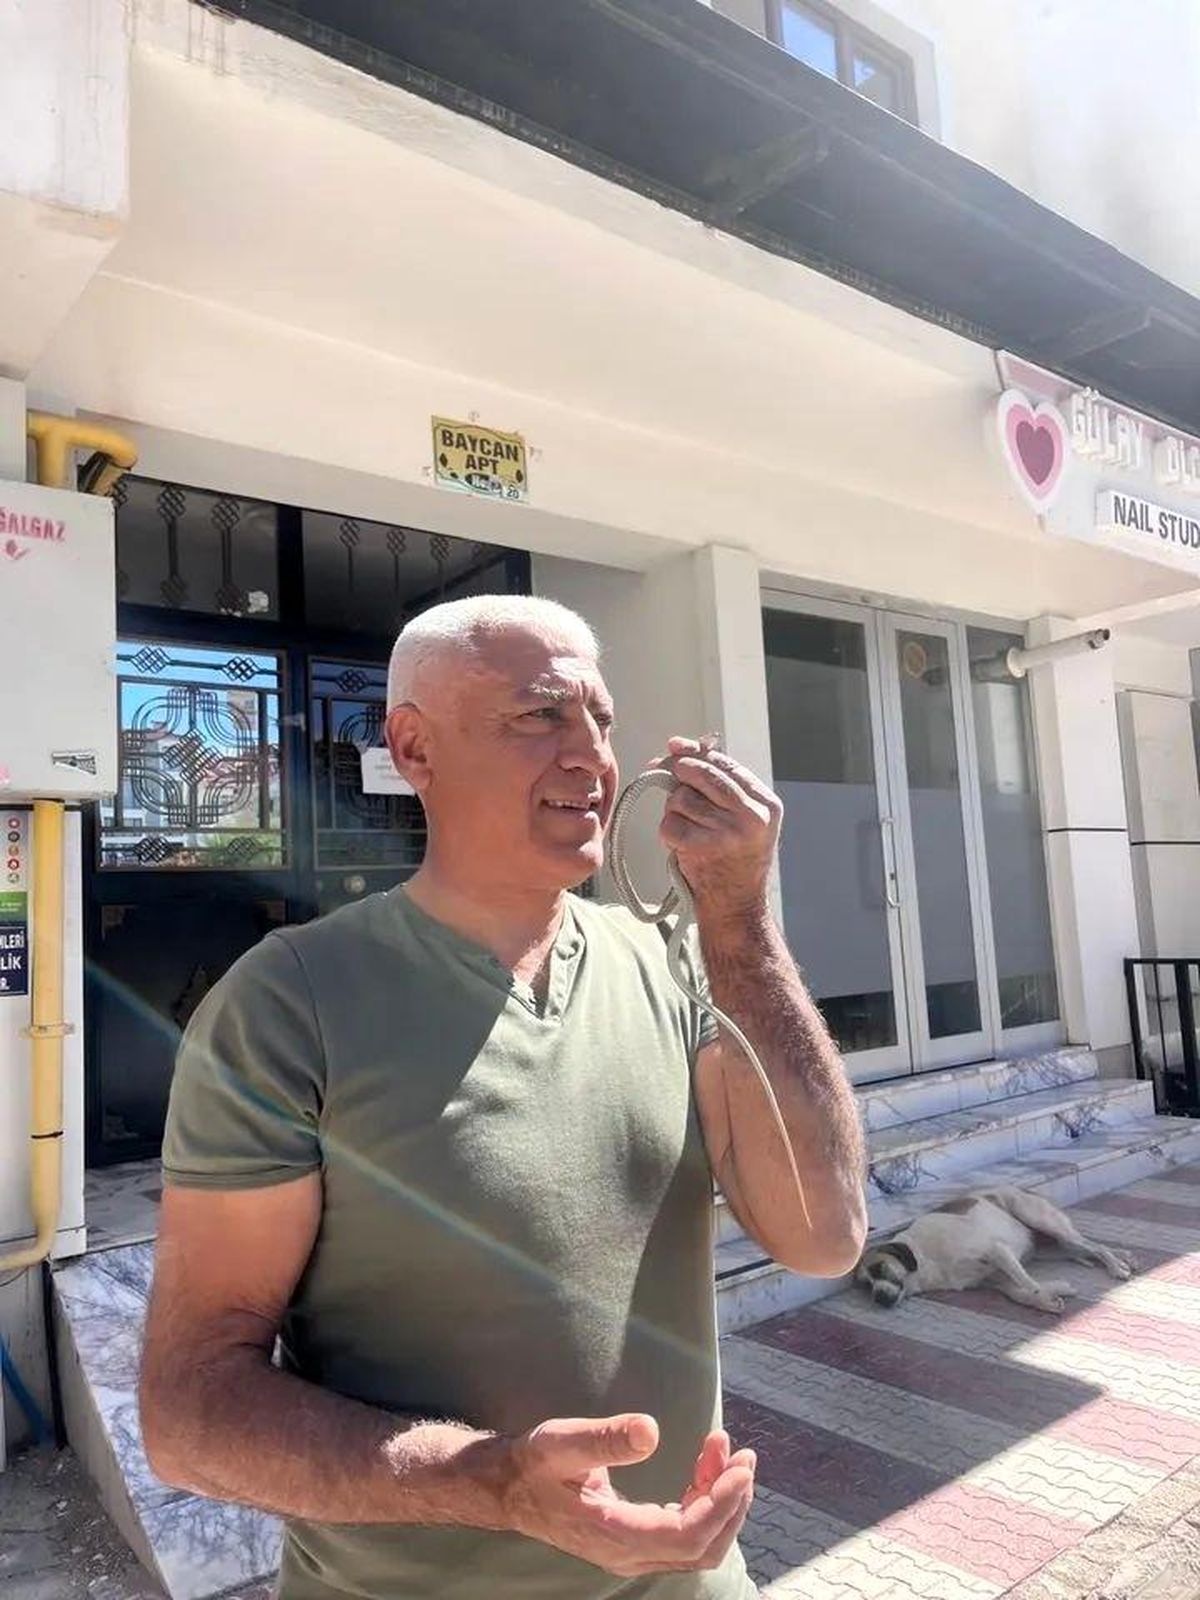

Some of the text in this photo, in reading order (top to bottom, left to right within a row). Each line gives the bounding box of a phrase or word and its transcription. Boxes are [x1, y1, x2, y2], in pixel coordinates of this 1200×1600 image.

[441, 428, 519, 463] BAYCAN
[465, 454, 500, 475] APT
[1113, 495, 1200, 549] NAIL STUD
